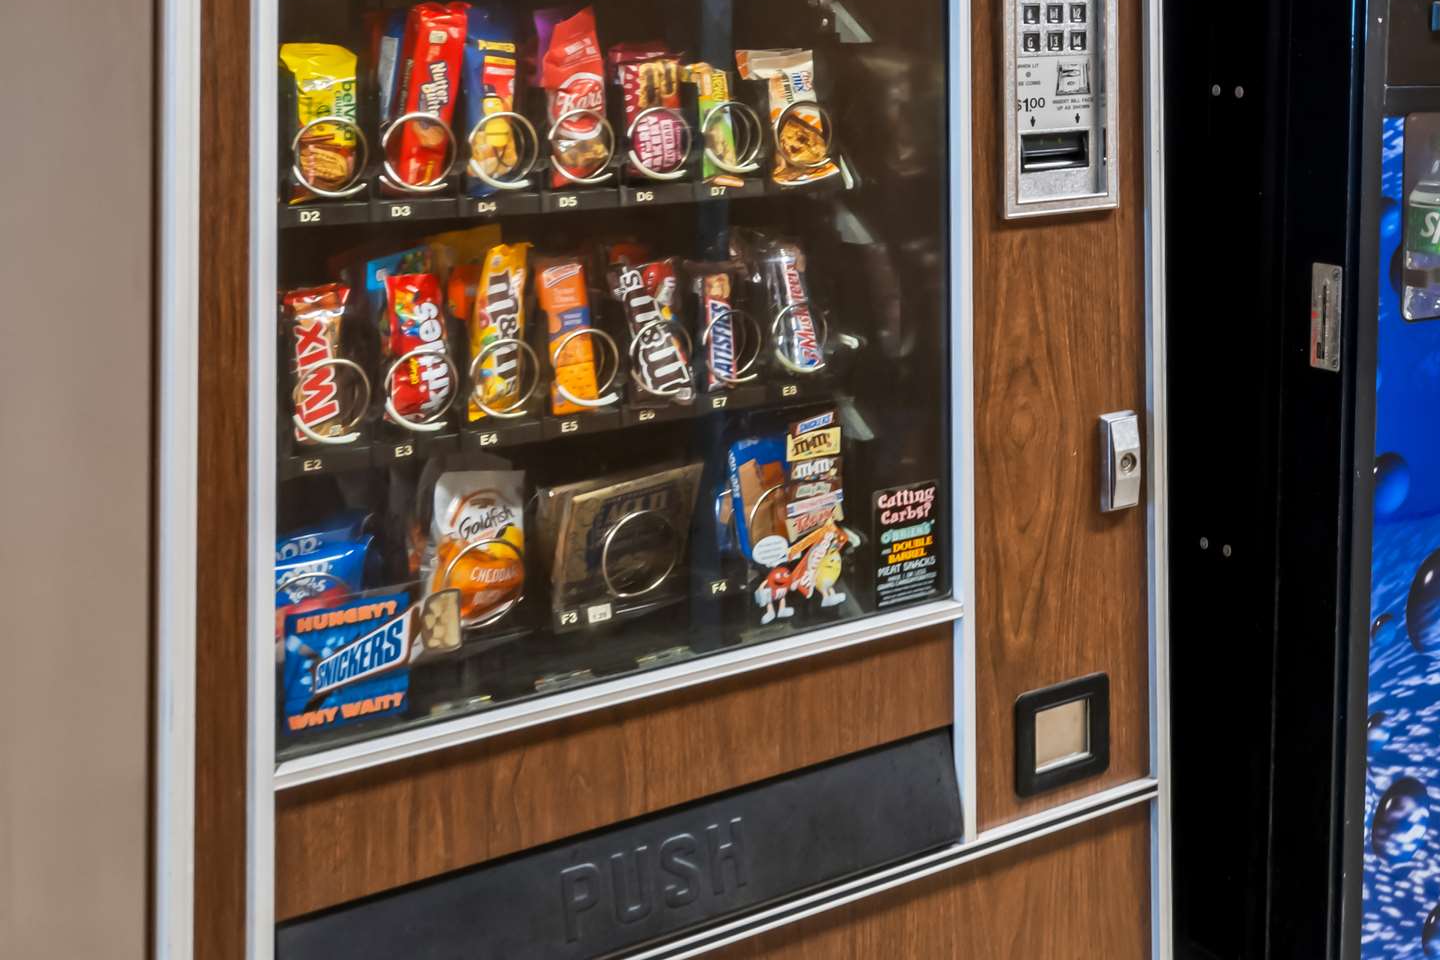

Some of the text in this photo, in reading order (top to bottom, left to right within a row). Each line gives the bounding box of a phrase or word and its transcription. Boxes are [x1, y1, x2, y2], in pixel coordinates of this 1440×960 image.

[636, 191, 654, 202] D6
[709, 186, 727, 197] D7
[477, 201, 496, 213] D4
[559, 196, 578, 208] D5
[299, 211, 321, 223] D2
[391, 205, 412, 217] D3
[412, 301, 450, 412] kittles
[782, 386, 798, 397] E8
[712, 397, 728, 408] E7
[561, 420, 579, 433] E5
[479, 433, 499, 446] E4
[395, 445, 414, 458] E3
[303, 459, 323, 472] E2
[878, 486, 936, 509] Cutting
[881, 501, 932, 526] Carbs?
[458, 504, 516, 541] Goldfish
[892, 535, 934, 554] DOUBLE
[887, 548, 928, 565] BARREL
[877, 555, 937, 578] MEAT SNACKS
[711, 581, 728, 593] F4
[296, 600, 398, 633] HUNGRY?
[561, 612, 579, 624] F3
[316, 618, 404, 690] SNICKERS
[288, 692, 407, 731] WHY WAIT?
[560, 817, 748, 945] PUSH
